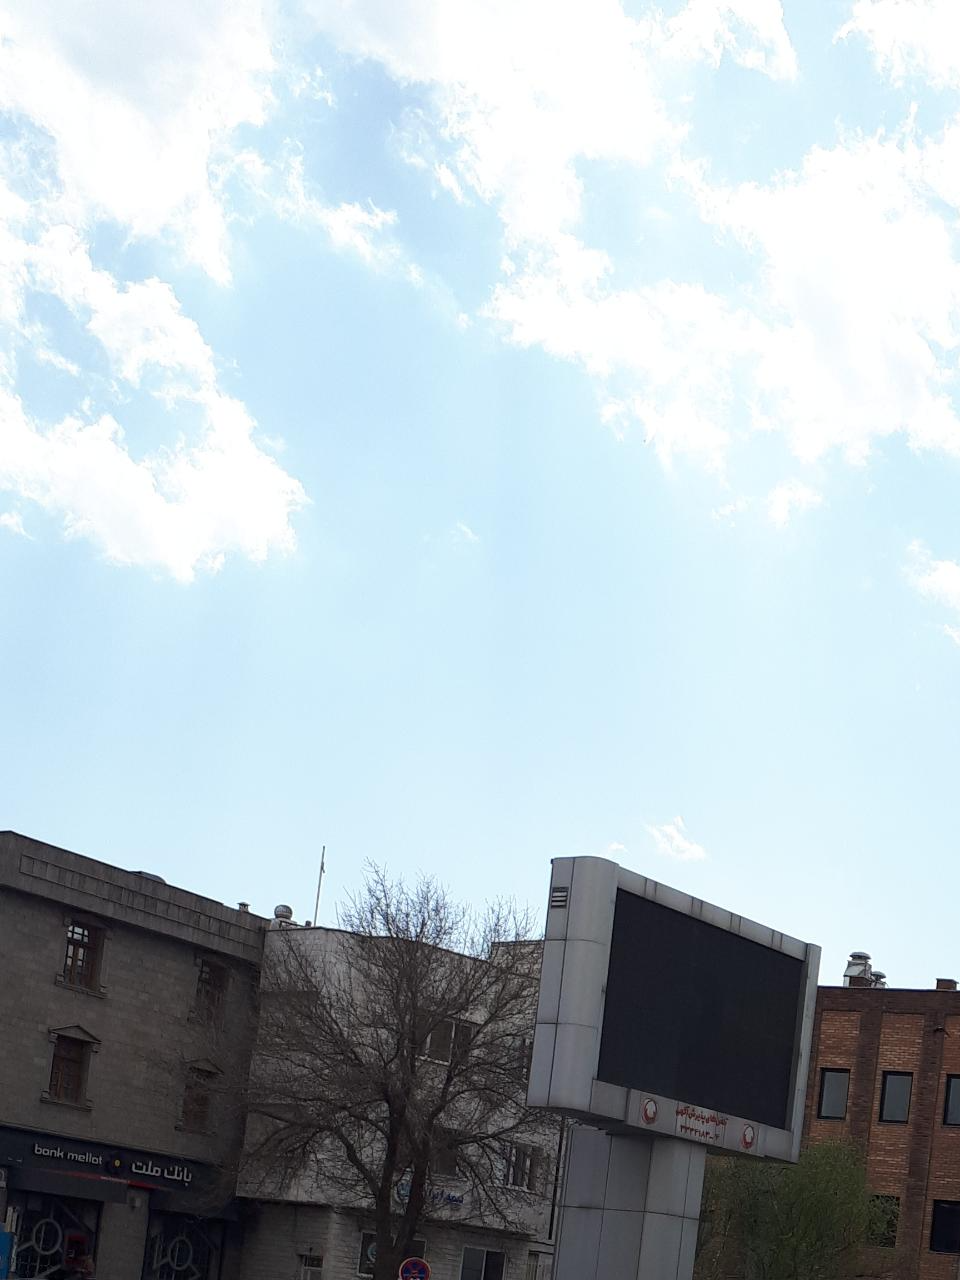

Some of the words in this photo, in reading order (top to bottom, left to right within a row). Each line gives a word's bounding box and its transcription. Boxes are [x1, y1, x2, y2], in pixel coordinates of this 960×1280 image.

[34, 1143, 65, 1159] bank
[67, 1150, 103, 1165] mellat
[131, 1160, 162, 1177] ملت
